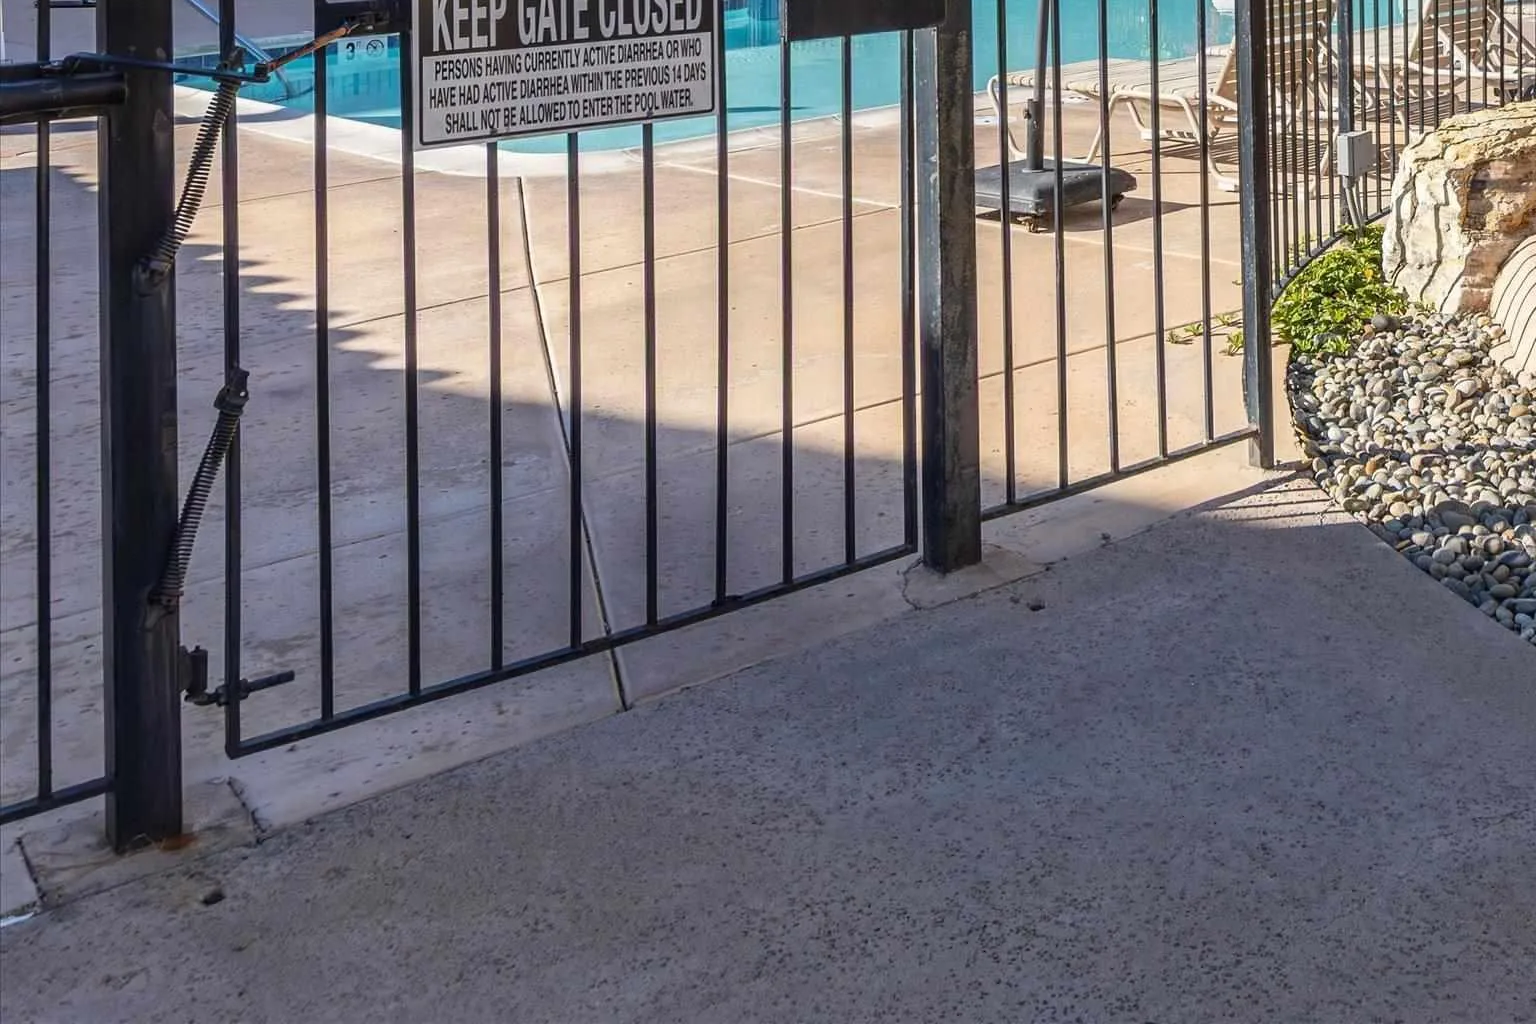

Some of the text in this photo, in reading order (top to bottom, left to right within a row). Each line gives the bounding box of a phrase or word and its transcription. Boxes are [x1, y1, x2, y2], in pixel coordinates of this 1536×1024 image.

[434, 38, 701, 81] PERSONS HAVING CURRENTLY ACTIVE DIARRHEA OR WHO
[429, 62, 706, 109] HAVE HAD ACTIVE DIARRHEA WITHIN THE PREVIOUS 14 DAYS
[445, 88, 693, 134] SHALL NOT BE ALLOWED TO ENTER THE POOL WATER.
